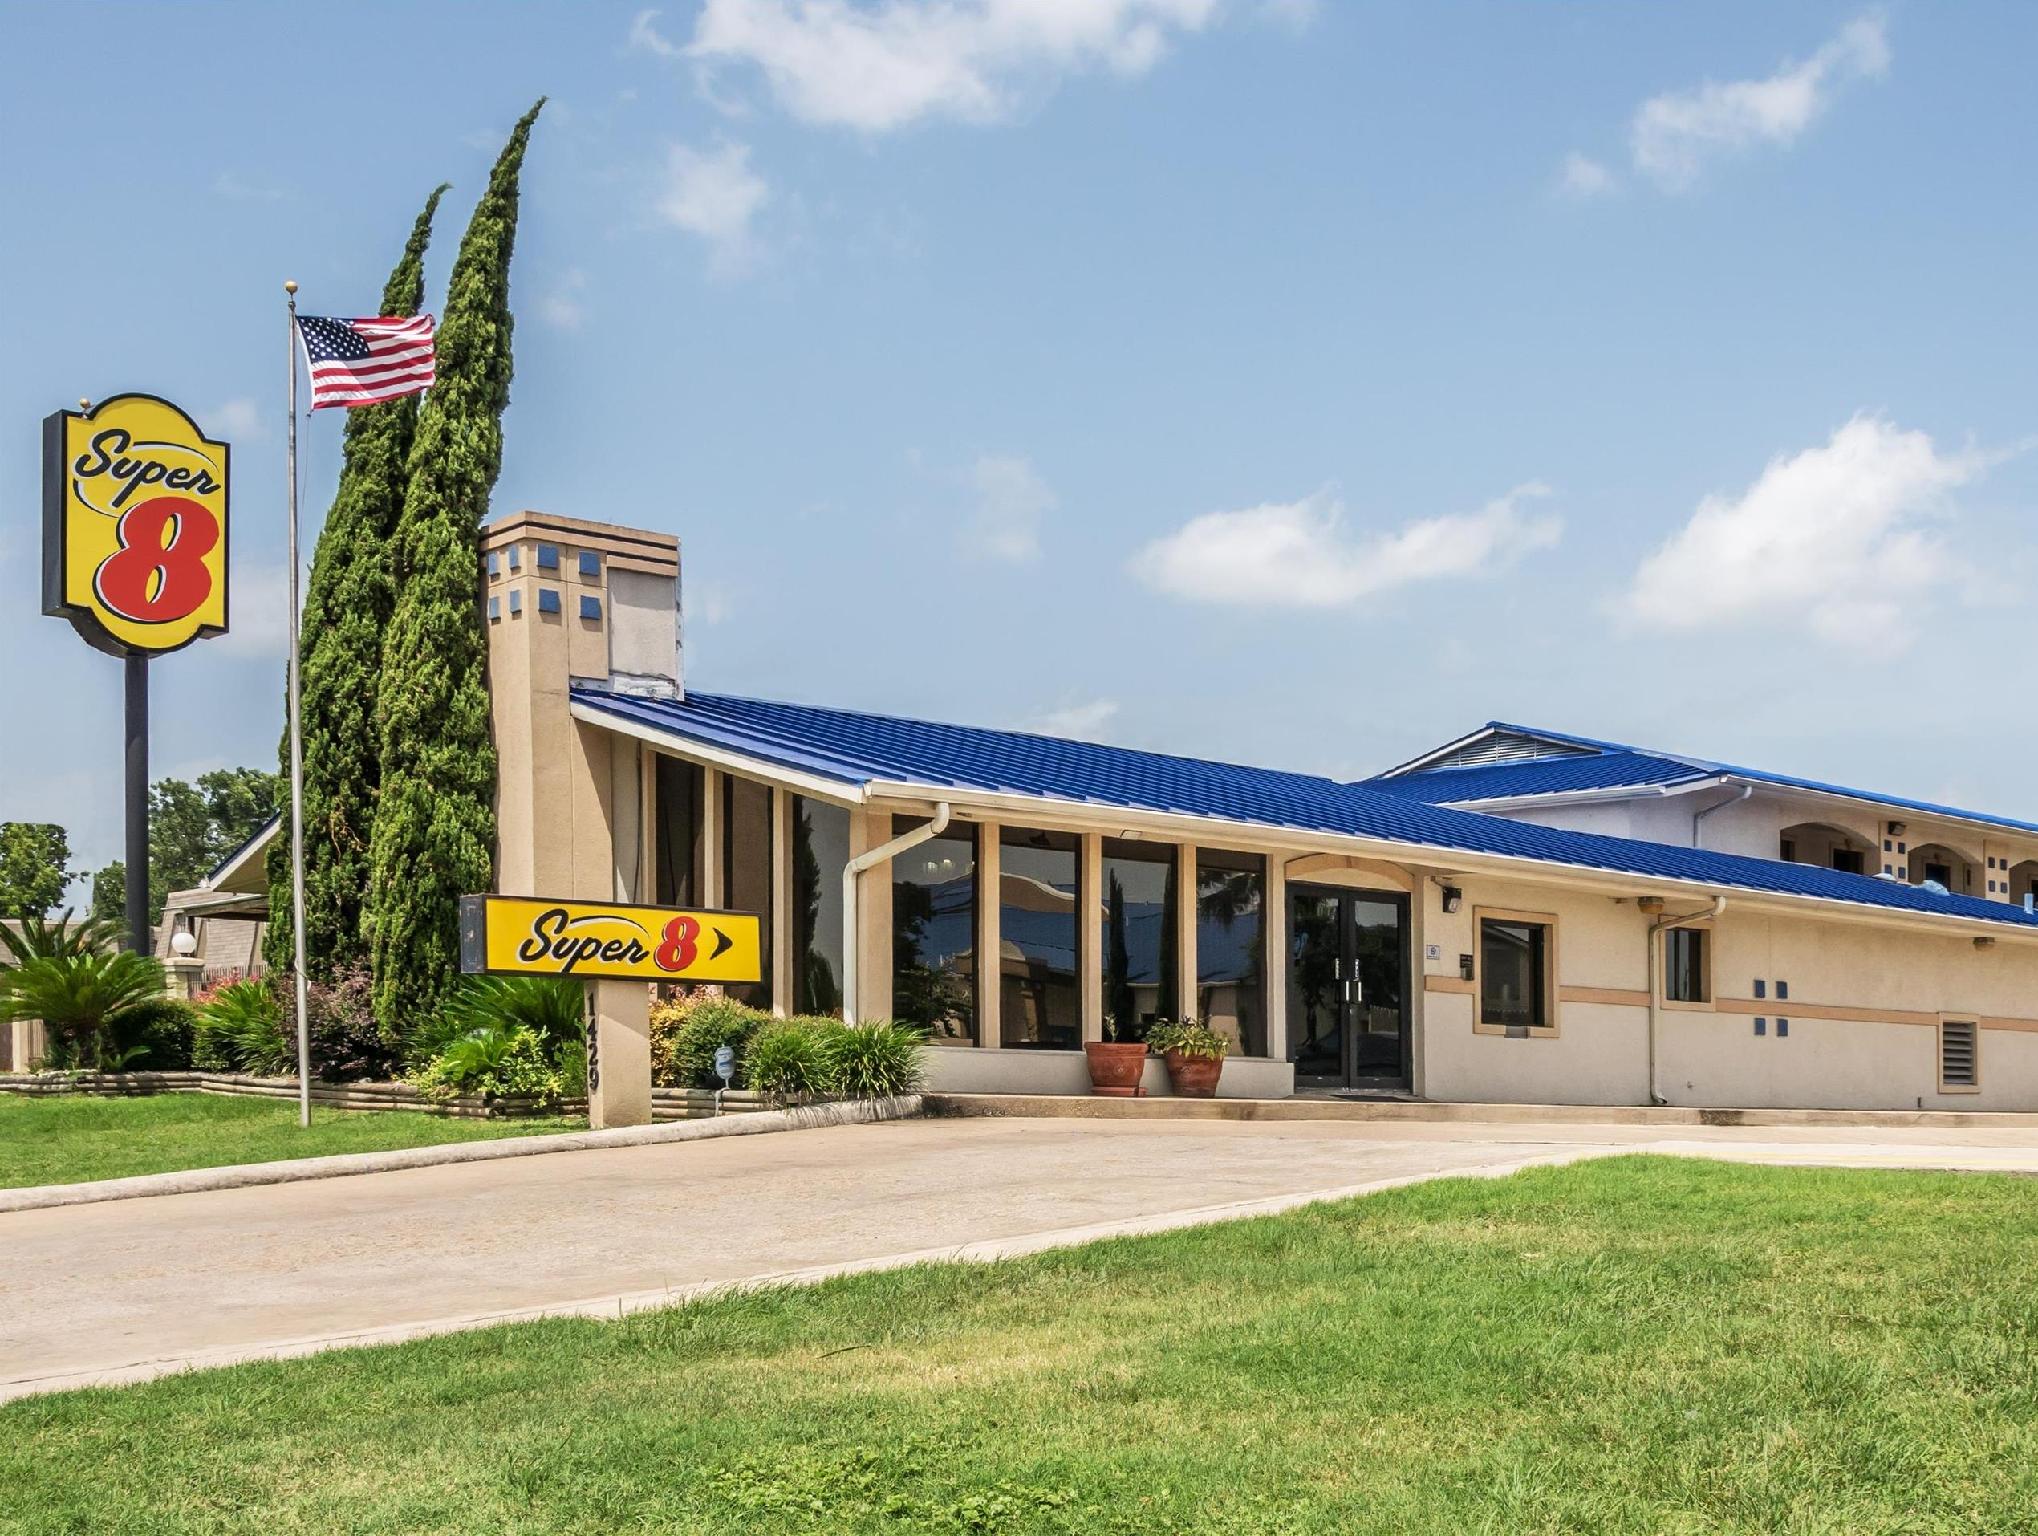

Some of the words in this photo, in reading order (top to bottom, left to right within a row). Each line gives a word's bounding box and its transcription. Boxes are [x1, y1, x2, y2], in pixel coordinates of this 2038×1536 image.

[74, 428, 221, 508] Super
[92, 496, 219, 624] 8
[518, 908, 649, 974] Super
[654, 915, 700, 972] 8
[586, 992, 600, 1092] 1429
